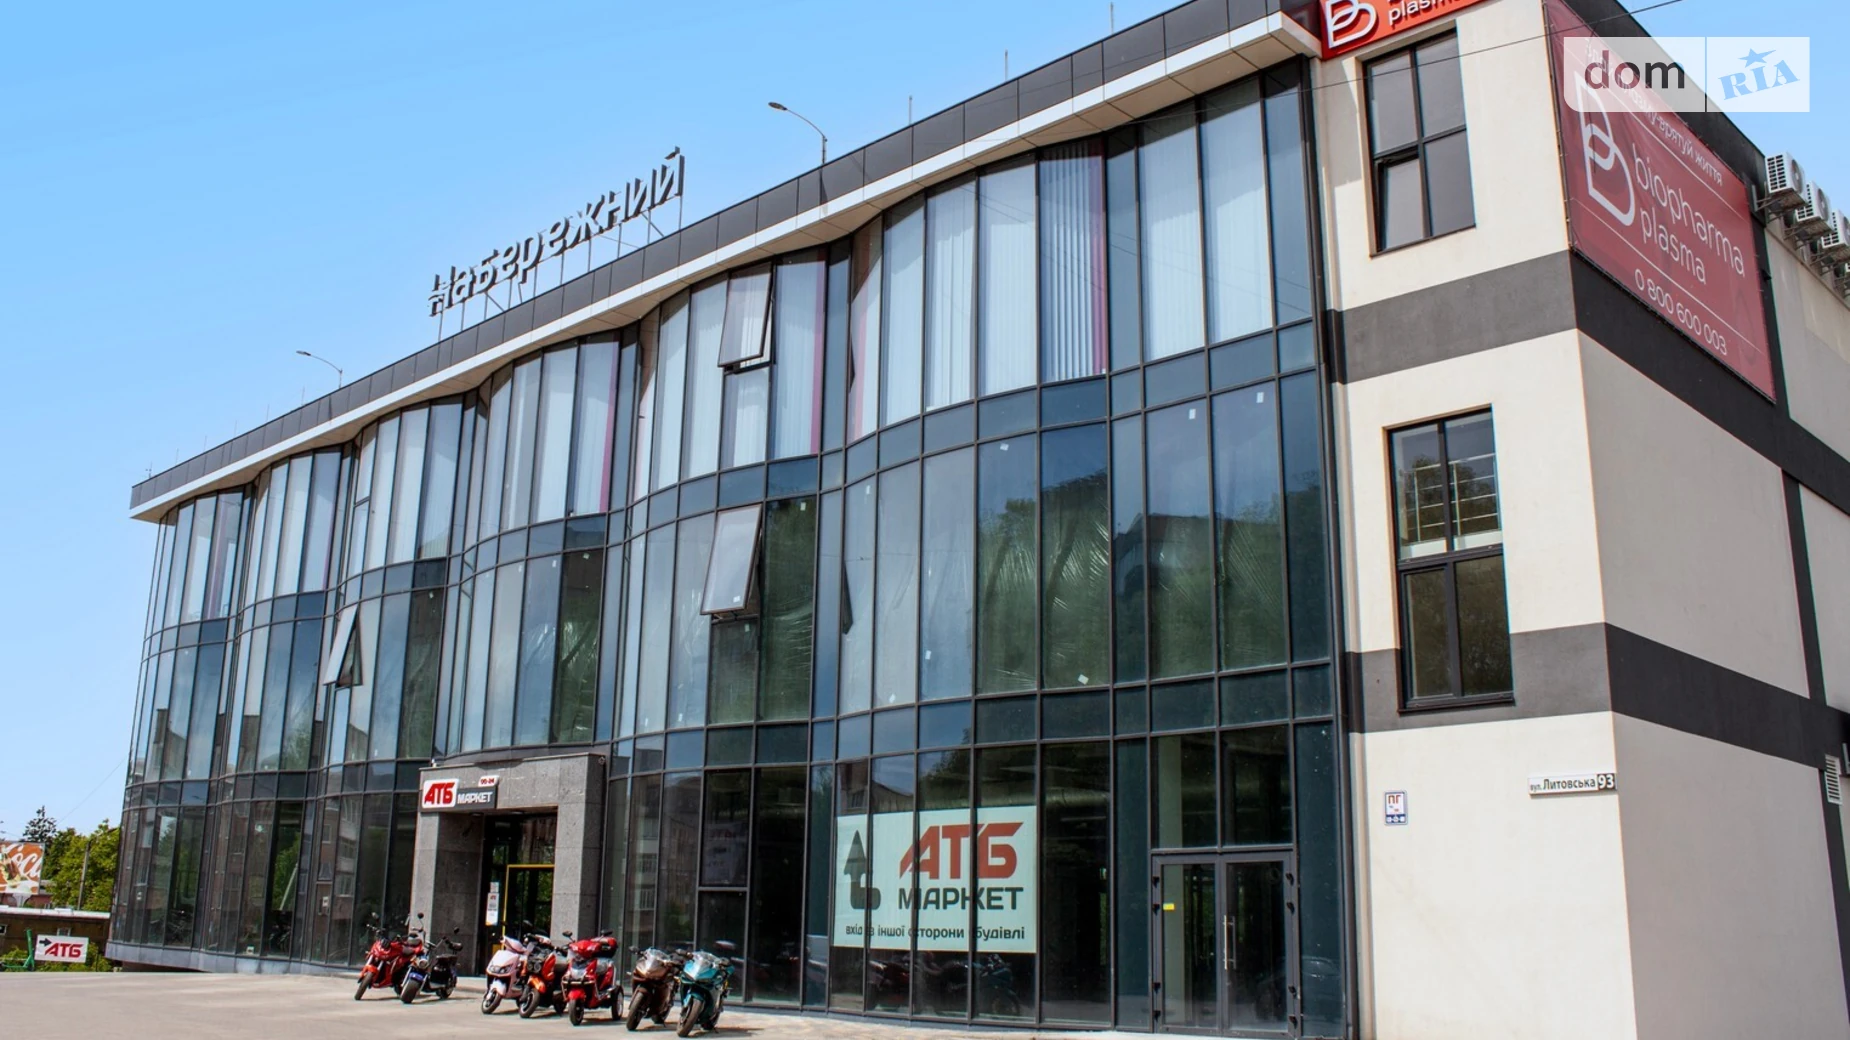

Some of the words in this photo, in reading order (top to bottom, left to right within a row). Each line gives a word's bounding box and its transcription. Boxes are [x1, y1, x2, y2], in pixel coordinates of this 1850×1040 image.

[1388, 0, 1460, 26] plas
[1633, 143, 1745, 277] biopharma
[428, 146, 685, 317] Набережний
[1640, 206, 1706, 285] plasma
[1635, 268, 1645, 292] 0
[1647, 278, 1674, 315] 800
[1676, 301, 1702, 336] 600
[1703, 322, 1727, 356] 003
[424, 782, 455, 805] АТБ
[457, 792, 493, 804] МАРКЕТ
[1543, 778, 1596, 791] Литовська
[1598, 774, 1614, 789] 93
[899, 822, 1024, 880] АТБ
[898, 886, 1024, 910] МАРКЕТ
[845, 923, 863, 936] вхід
[877, 924, 906, 938] іншої
[45, 942, 83, 958] АТБ
